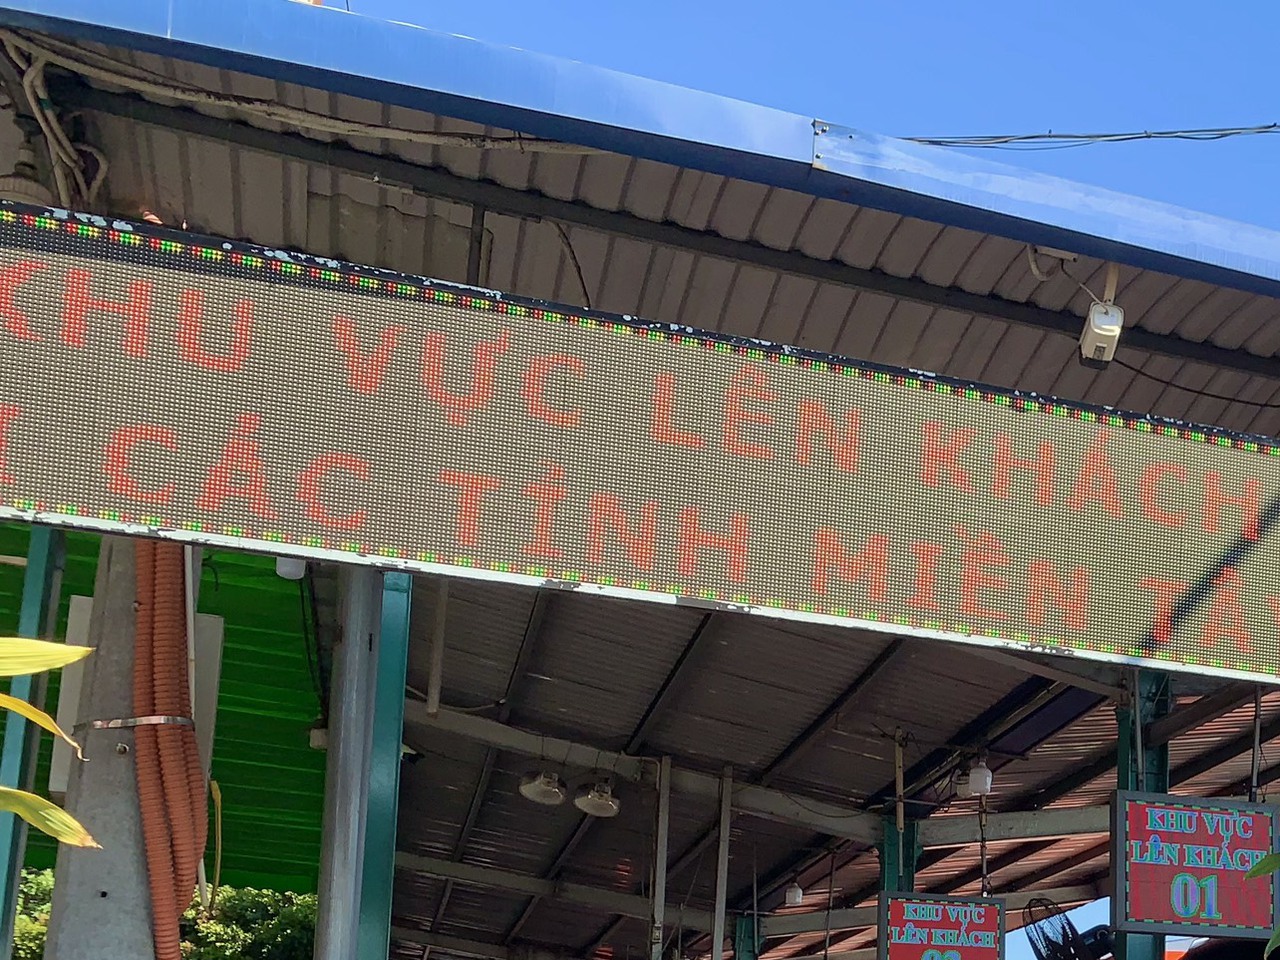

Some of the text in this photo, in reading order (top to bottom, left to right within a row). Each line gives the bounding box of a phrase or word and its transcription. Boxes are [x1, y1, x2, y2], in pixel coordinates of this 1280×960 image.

[331, 312, 588, 428] VỰC
[649, 363, 863, 475] LÊN
[920, 419, 1264, 542] KHÁCH
[105, 413, 371, 531] CÁC
[812, 522, 1092, 631] MIỀN
[1145, 807, 1254, 843] KHU VỰC
[1130, 834, 1180, 866] LÊN
[1170, 872, 1223, 920] 01
[903, 903, 985, 927] KHU VỰC
[891, 922, 996, 948] LÊN KHÁCH
